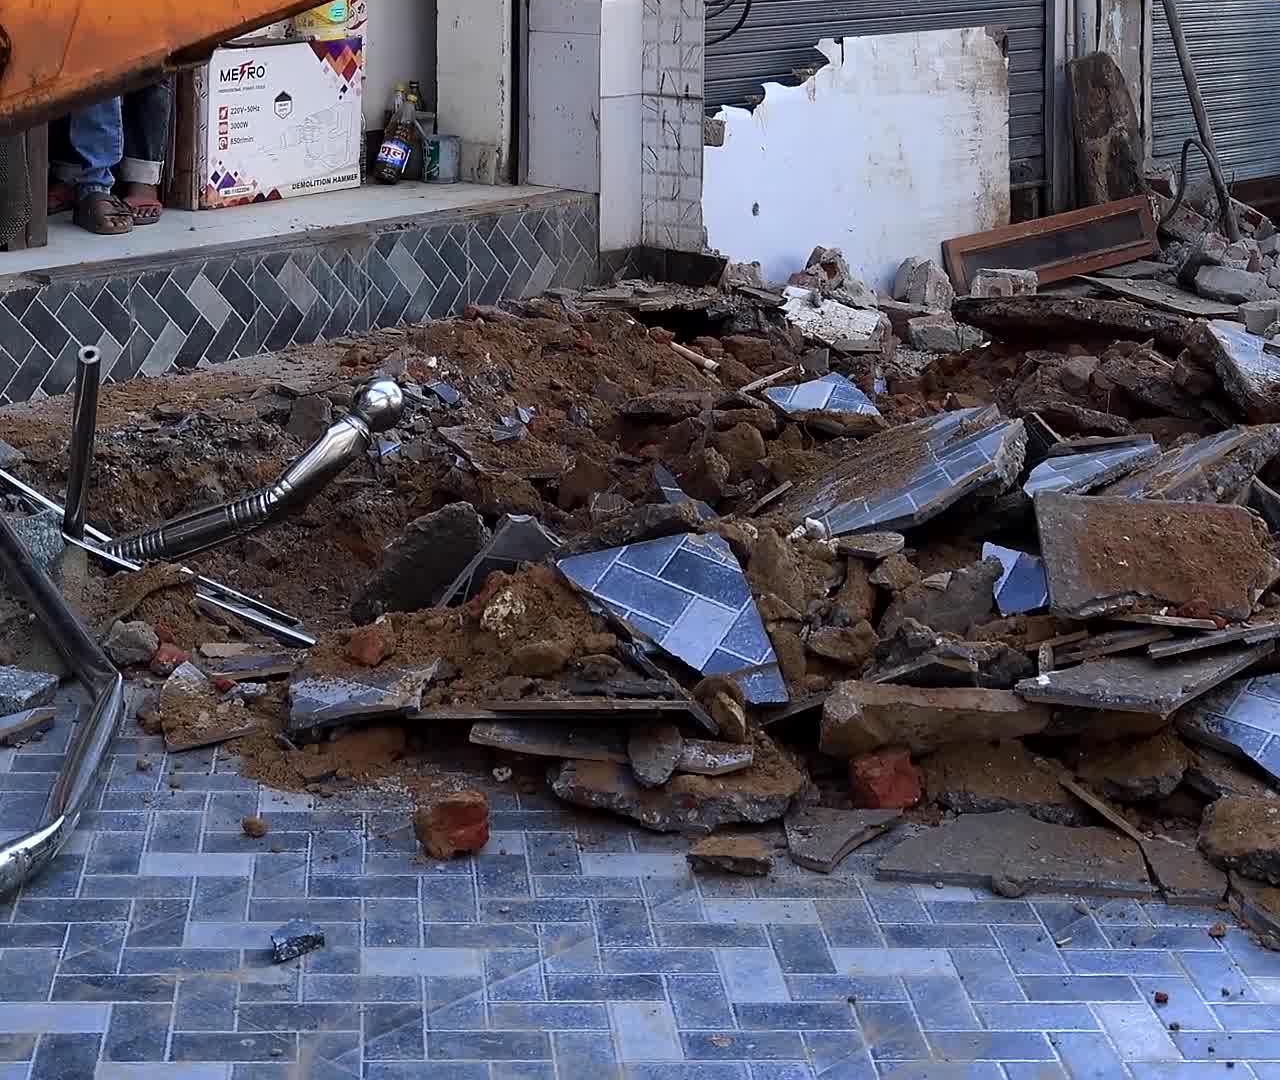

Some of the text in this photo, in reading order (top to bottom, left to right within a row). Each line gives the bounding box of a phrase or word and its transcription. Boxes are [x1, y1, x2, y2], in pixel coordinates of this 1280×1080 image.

[219, 60, 266, 85] METRO
[291, 172, 358, 190] DEMOLITION HAMMER
